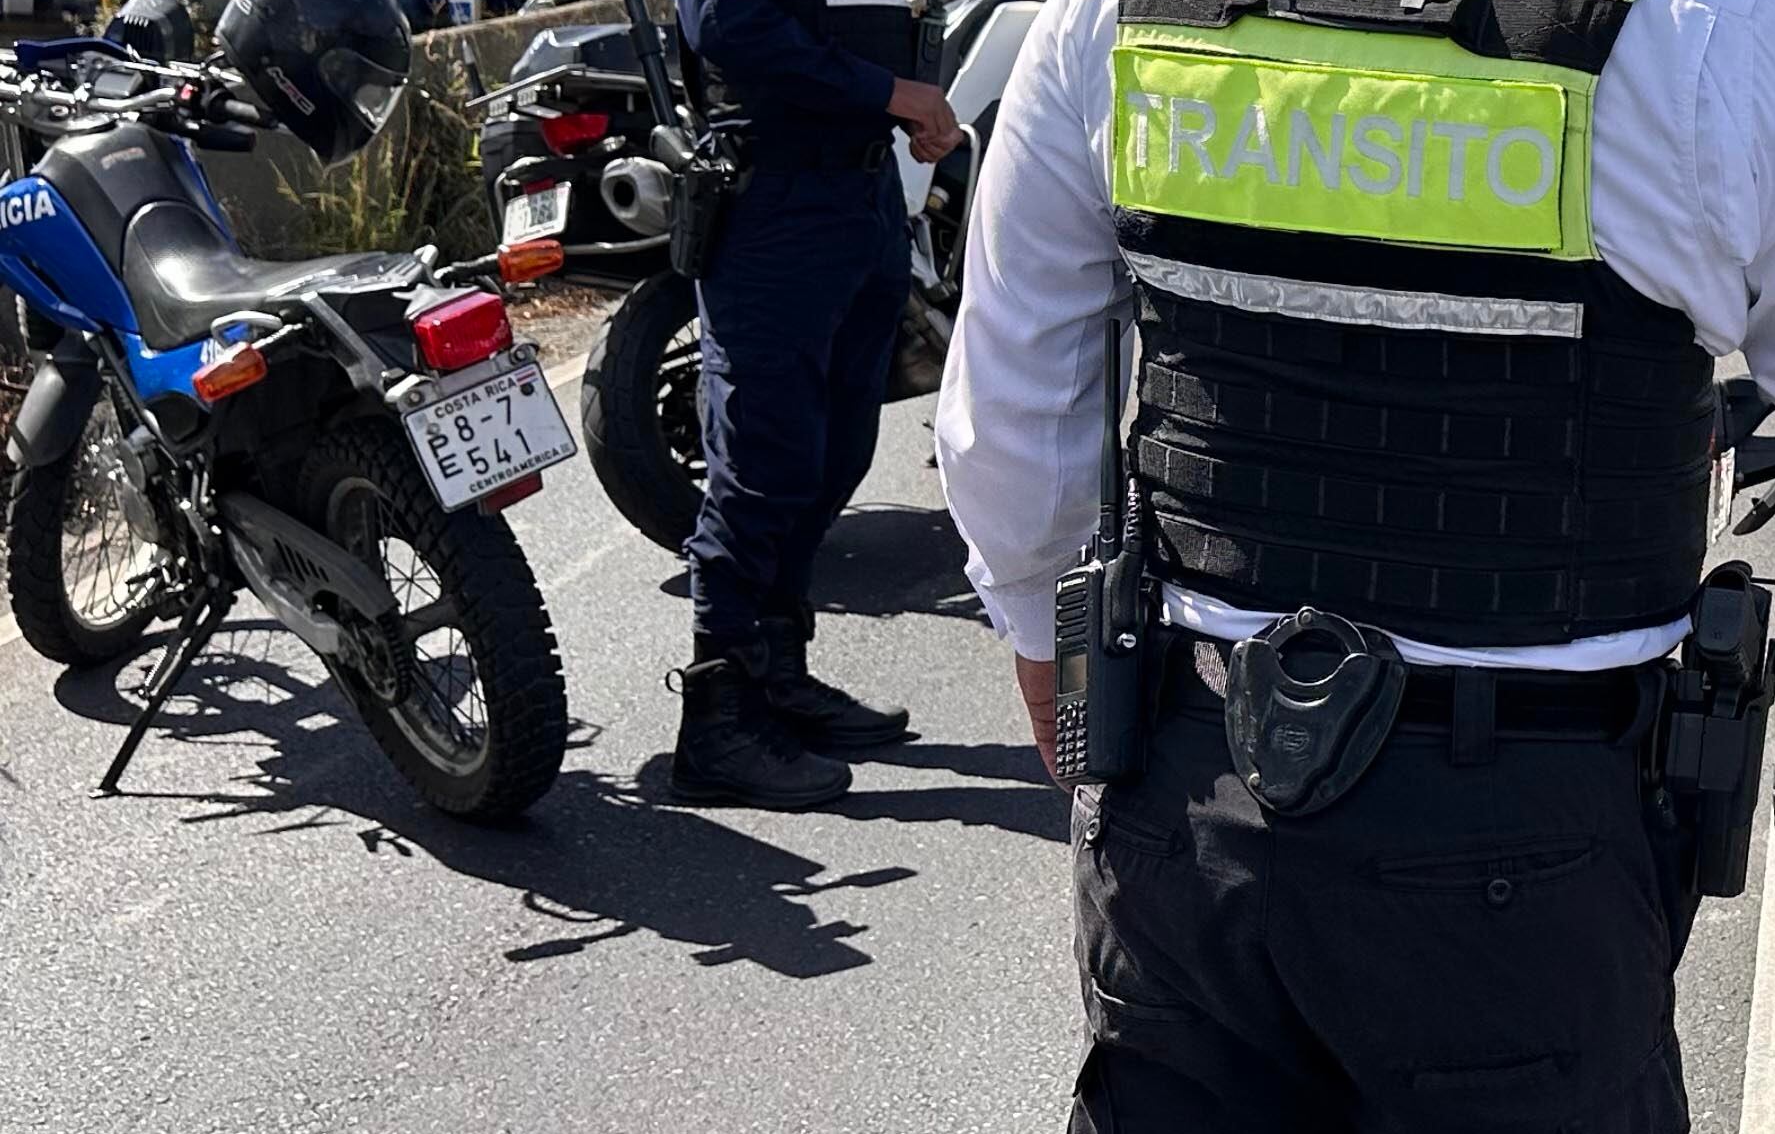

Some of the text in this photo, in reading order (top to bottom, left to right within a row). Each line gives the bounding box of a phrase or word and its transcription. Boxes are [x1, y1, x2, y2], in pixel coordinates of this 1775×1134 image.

[1125, 90, 1558, 206] TRANSITO
[0, 189, 57, 230] ICIA
[434, 376, 517, 419] COSTA RICA
[454, 395, 513, 442] 8-7
[466, 428, 532, 475] 541
[469, 447, 560, 494] CENTROAMERICA
